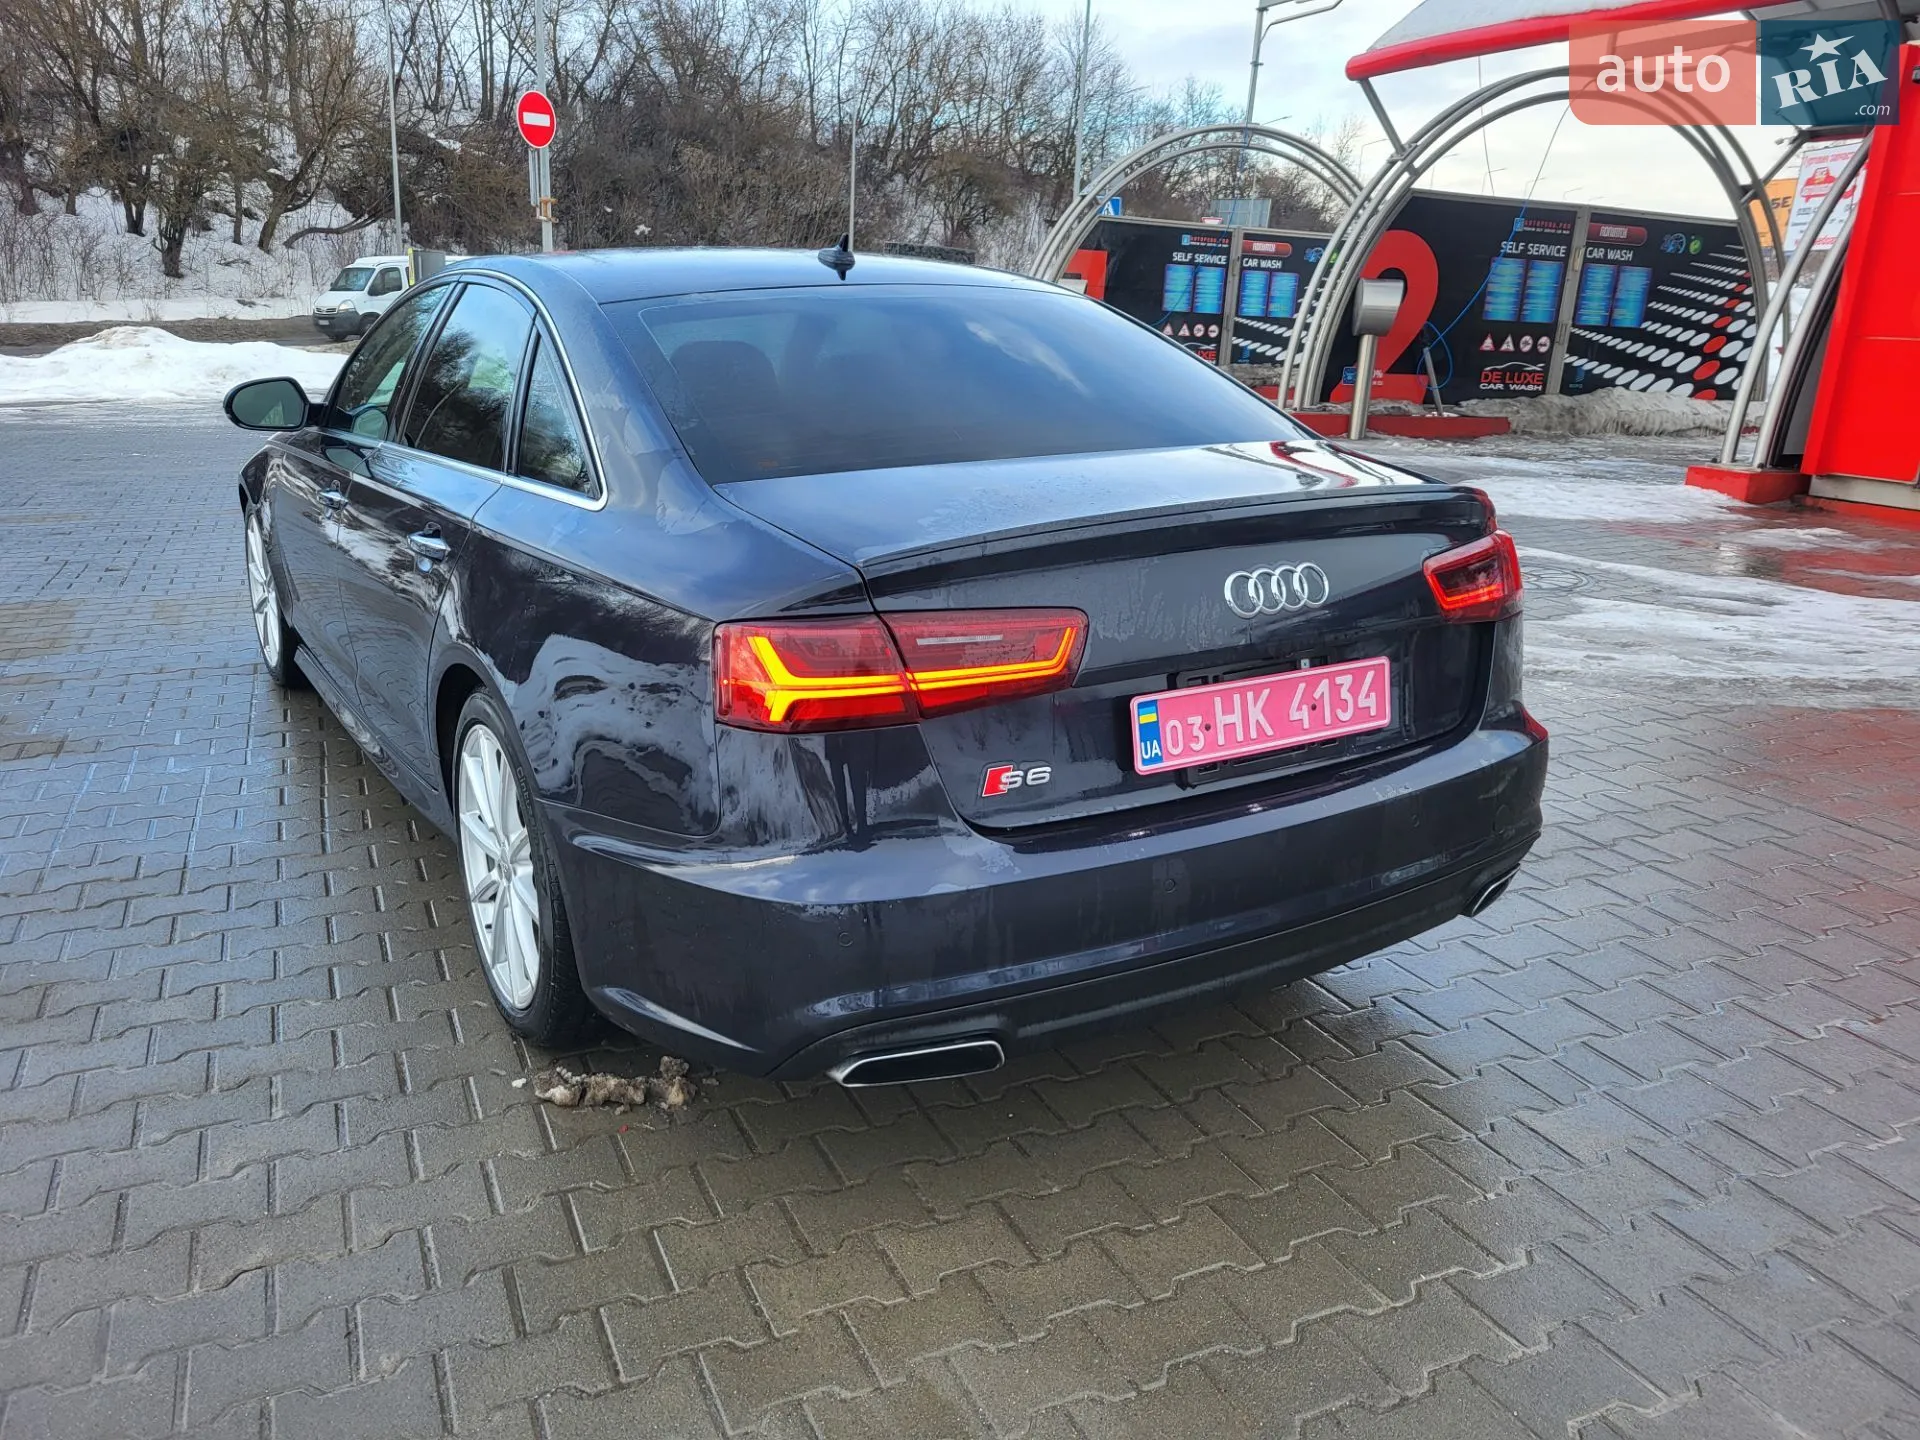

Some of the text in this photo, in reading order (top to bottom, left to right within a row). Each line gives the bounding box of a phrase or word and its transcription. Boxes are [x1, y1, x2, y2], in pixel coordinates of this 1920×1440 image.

[1172, 252, 1282, 269] SELF SERVICE CAR WASH
[1500, 240, 1633, 261] SELF SERVICE CAR WASH
[1480, 371, 1545, 385] DE LUXE
[1165, 670, 1377, 756] 03 HK 4134
[1141, 740, 1162, 760] UA
[998, 766, 1052, 791] S6
